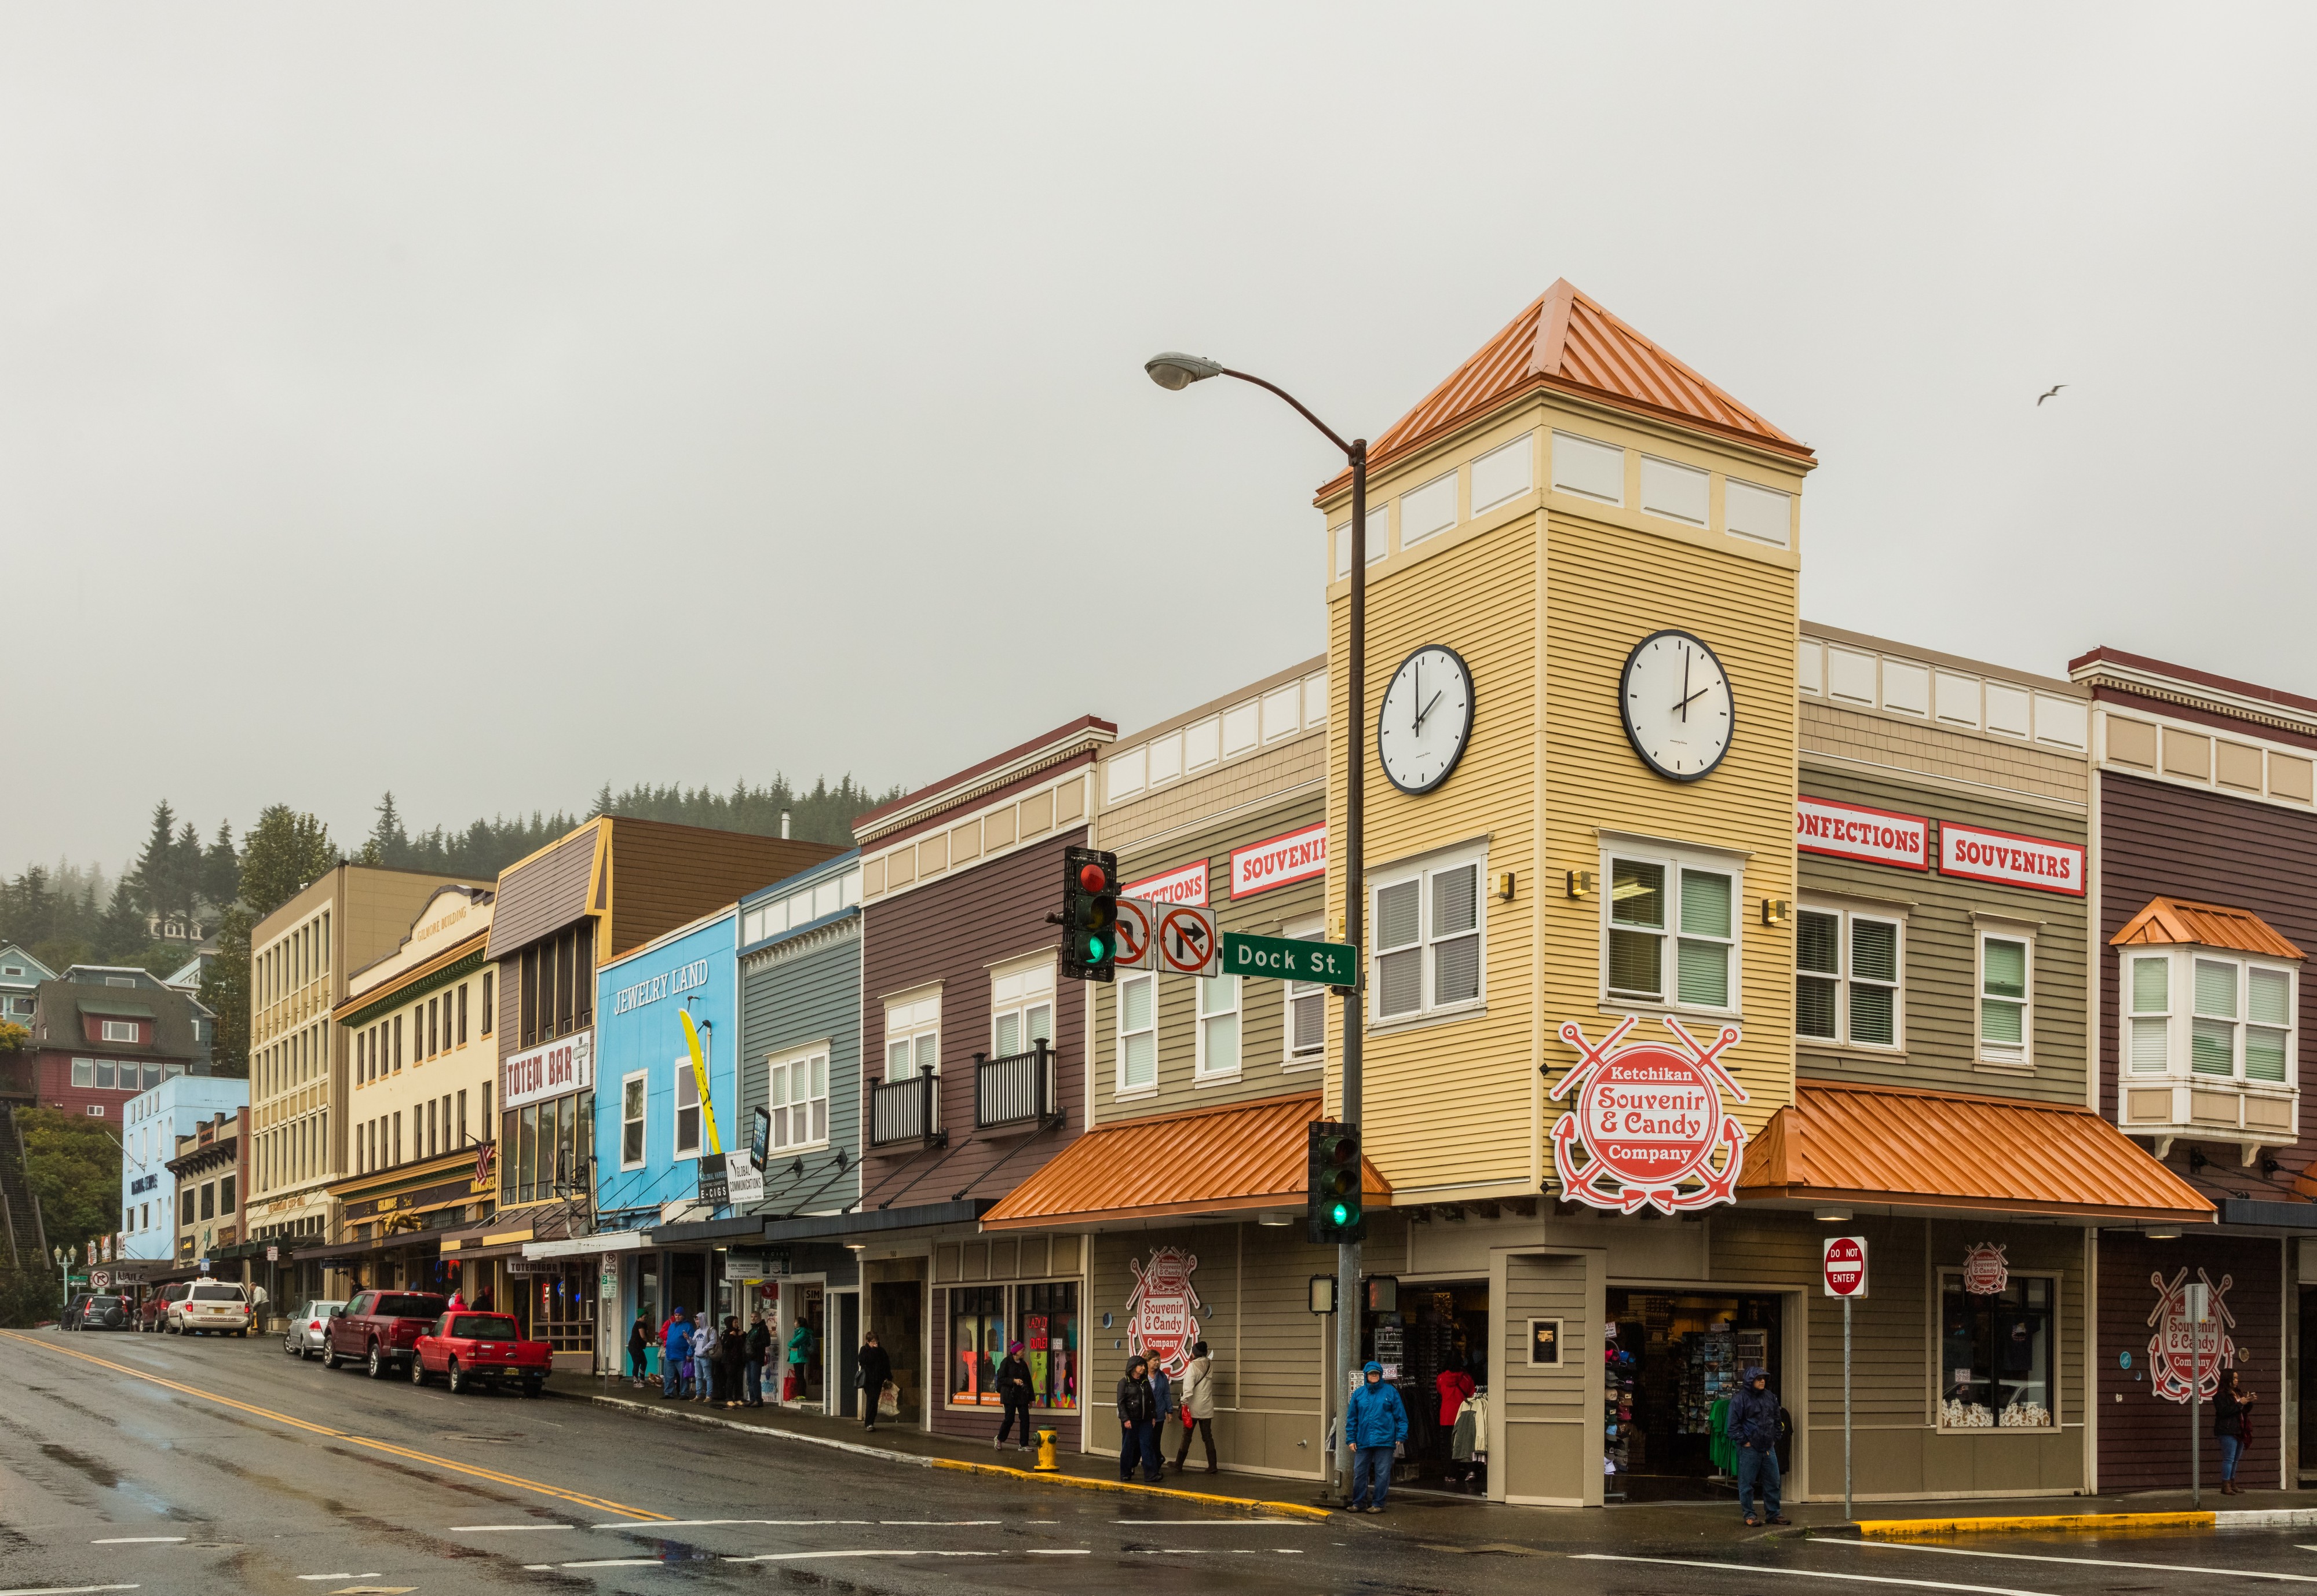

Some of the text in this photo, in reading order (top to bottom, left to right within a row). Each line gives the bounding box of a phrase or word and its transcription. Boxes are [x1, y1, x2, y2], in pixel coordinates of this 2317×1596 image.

[1956, 839, 2070, 879] SOUVENIRS
[417, 906, 466, 942] GILMORE BUILDING
[1238, 944, 1341, 974] Dock St.
[614, 959, 708, 1016] JEWELRY LAND
[508, 1046, 572, 1097] TOTEM BAR
[1611, 1067, 1693, 1081] Ketchikan
[1598, 1086, 1705, 1110] Souvenir
[1600, 1111, 1701, 1139] & Candy
[1609, 1145, 1692, 1164] Company
[715, 1171, 727, 1179] VAPORS
[737, 1165, 750, 1177] GLOBAL
[730, 1177, 761, 1192] COMMUNICATIONS
[1830, 1248, 1858, 1258] DO NOT
[511, 1263, 557, 1272] TOTEM BAR
[1833, 1273, 1855, 1283] ENTER
[806, 1290, 820, 1299] SIM
[1145, 1299, 1183, 1314] Souvenir
[1028, 1317, 1041, 1328] LAZY
[1145, 1316, 1182, 1332] & Candy
[1030, 1338, 1047, 1349] OUTLET
[1147, 1338, 1178, 1350] Company
[2170, 1333, 2178, 1349] &
[2174, 1356, 2210, 1369] Comany
